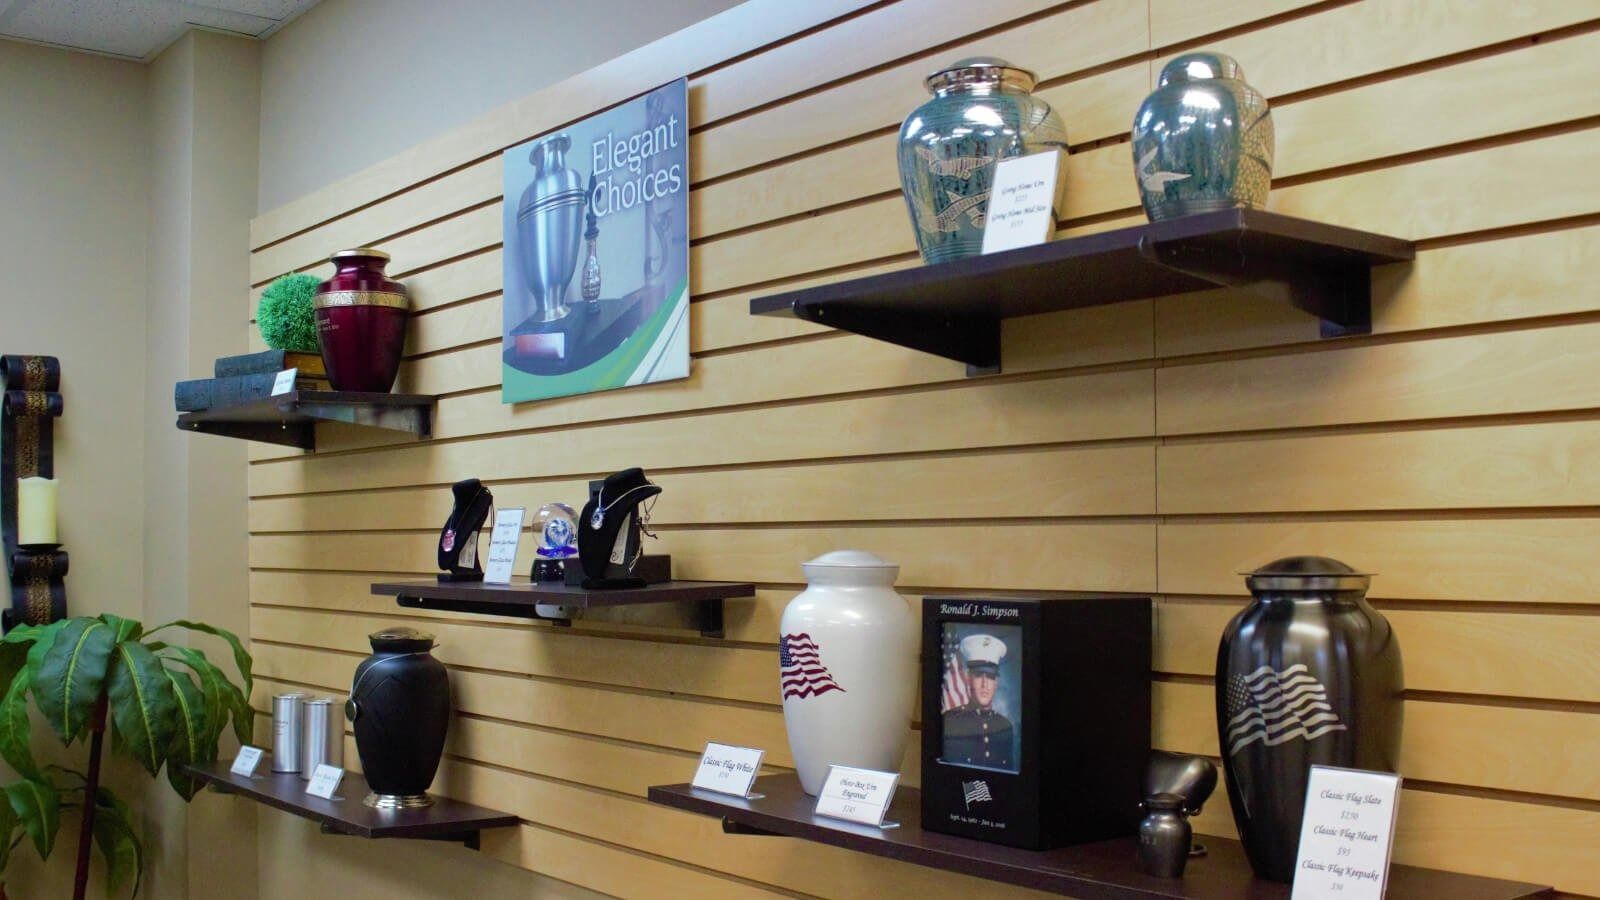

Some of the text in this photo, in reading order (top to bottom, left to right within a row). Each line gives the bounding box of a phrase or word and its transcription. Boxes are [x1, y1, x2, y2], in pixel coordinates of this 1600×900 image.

[592, 112, 678, 176] Elegant
[592, 163, 681, 217] Choices
[940, 602, 1019, 620] Ronald J. Simpson
[722, 759, 735, 772] Flag
[736, 760, 754, 774] White
[1320, 789, 1382, 805] Classic Flag Slate
[1313, 824, 1379, 842] Classic Flag Heart
[1302, 858, 1380, 882] Classic Flag Keepsake
